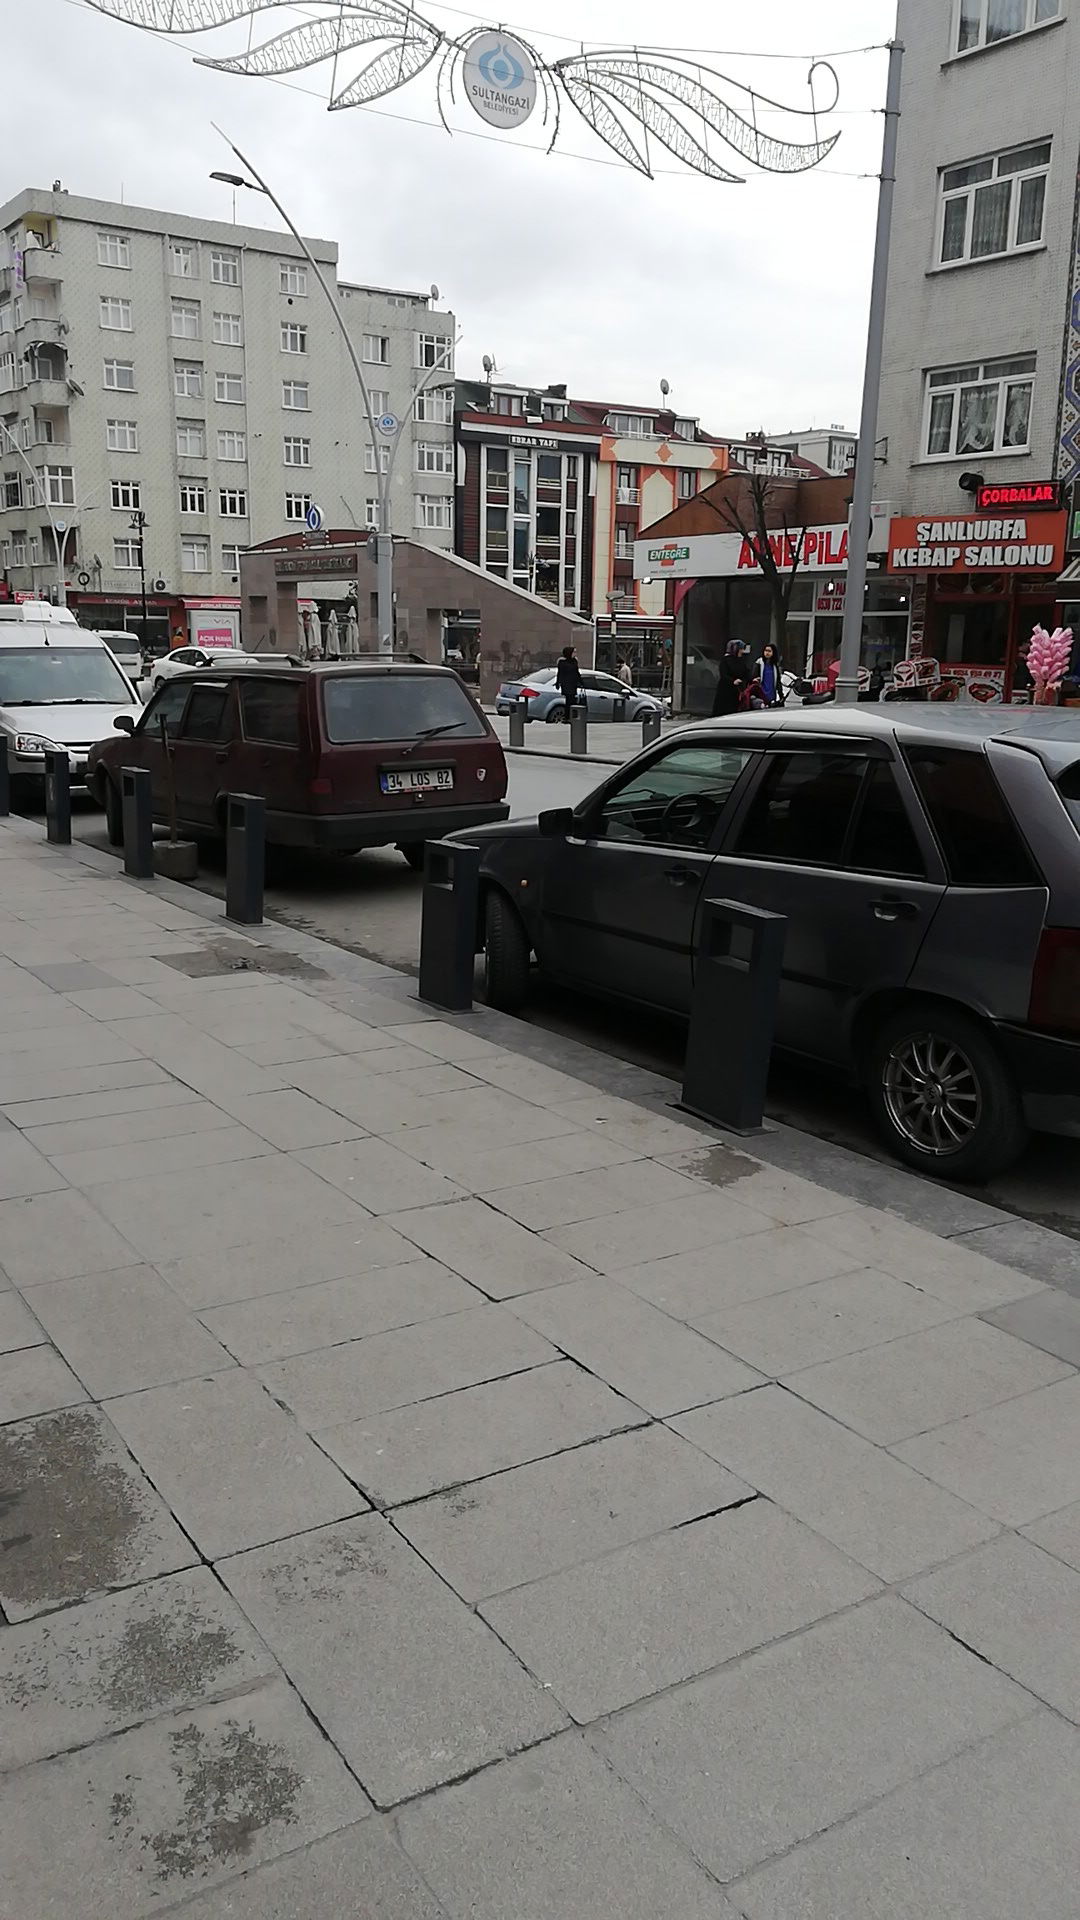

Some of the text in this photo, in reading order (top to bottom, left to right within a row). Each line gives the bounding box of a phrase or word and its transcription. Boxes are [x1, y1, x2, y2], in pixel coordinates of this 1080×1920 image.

[472, 85, 530, 110] SULTANGAZİ
[483, 100, 519, 116] BELEDİYESİ
[981, 486, 1054, 507] ÇORBALAR
[916, 519, 1027, 546] ŞANLIURFA
[650, 548, 687, 560] ENTEGRE
[892, 544, 1054, 568] KEBAP SALONU
[388, 770, 450, 788] 34 LOS 82
